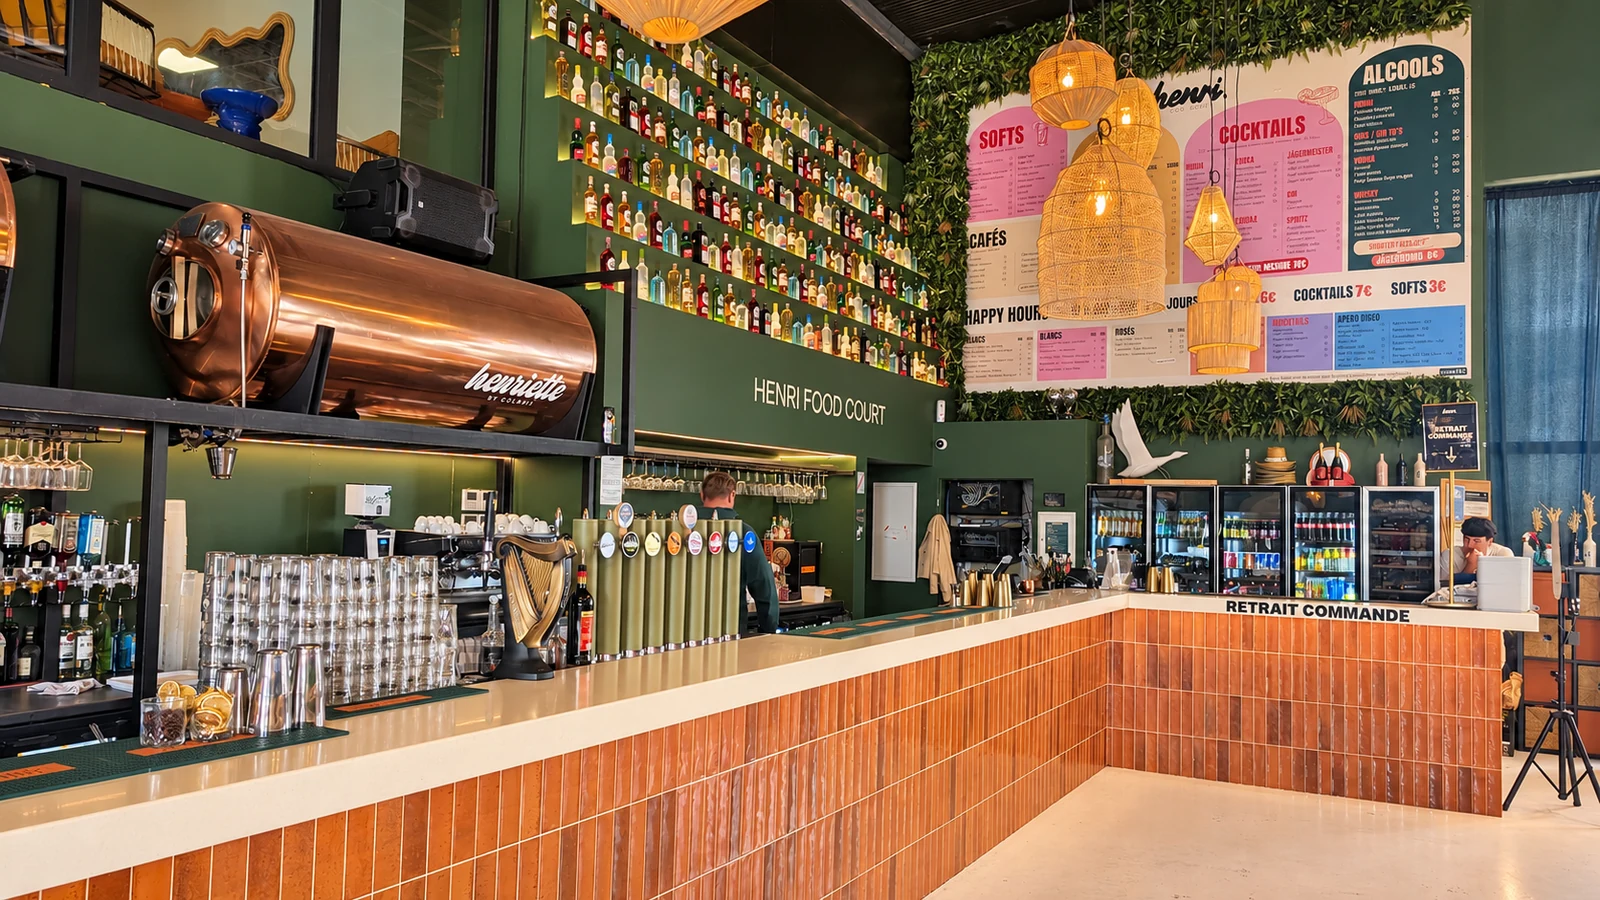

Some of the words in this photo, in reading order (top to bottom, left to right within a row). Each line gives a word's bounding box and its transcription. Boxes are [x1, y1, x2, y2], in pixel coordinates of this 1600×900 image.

[1363, 54, 1444, 85] ALCOOLS
[979, 125, 1024, 149] SOFTS
[1219, 115, 1306, 144] COCKTAILS
[969, 228, 1006, 249] CAFÉS
[1293, 285, 1353, 302] COCKTAILS
[1355, 284, 1372, 297] 7€
[1391, 280, 1427, 295] SOFTS
[1429, 279, 1446, 293] 3€
[1166, 296, 1198, 309] JOURS
[964, 307, 1004, 325] HAPPY
[1008, 305, 1048, 322] HOUR
[464, 363, 567, 401] henriette
[754, 377, 799, 409] HENRI
[803, 388, 842, 417] FOOD
[845, 398, 886, 425] COURT
[1226, 600, 1298, 616] RETRAIT
[1302, 604, 1410, 622] COMMANDE
